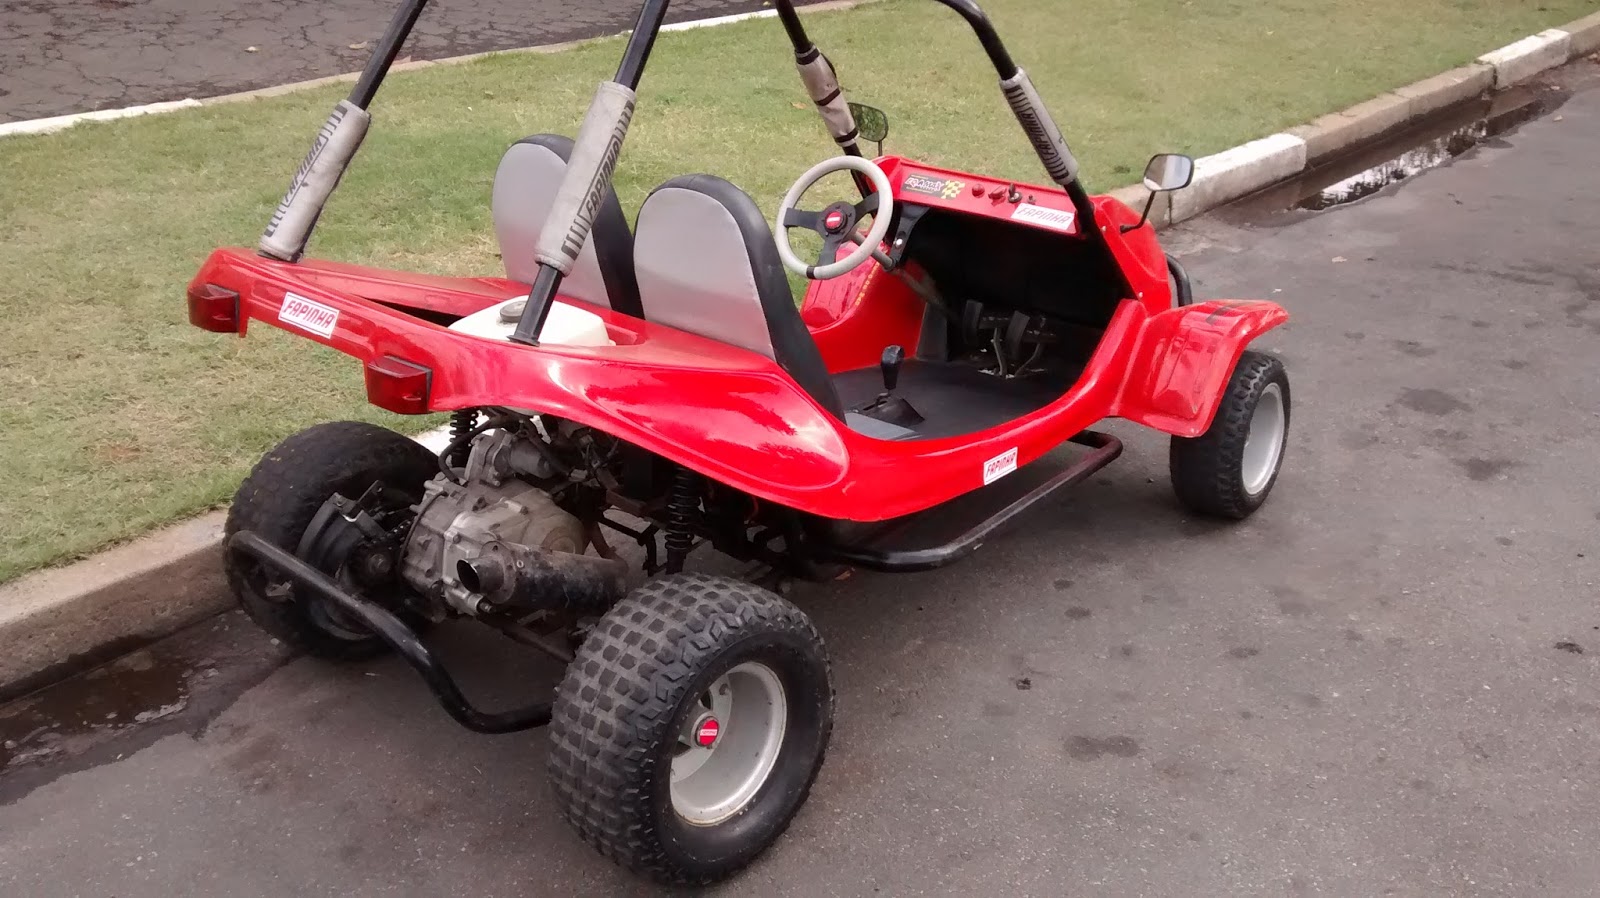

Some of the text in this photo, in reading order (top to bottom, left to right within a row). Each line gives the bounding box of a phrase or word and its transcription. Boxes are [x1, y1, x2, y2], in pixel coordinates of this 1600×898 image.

[585, 140, 620, 220] FAPINHA
[1017, 207, 1071, 224] FAPINHA
[283, 300, 336, 329] FAPINHA
[985, 451, 1016, 478] FAPINHA
